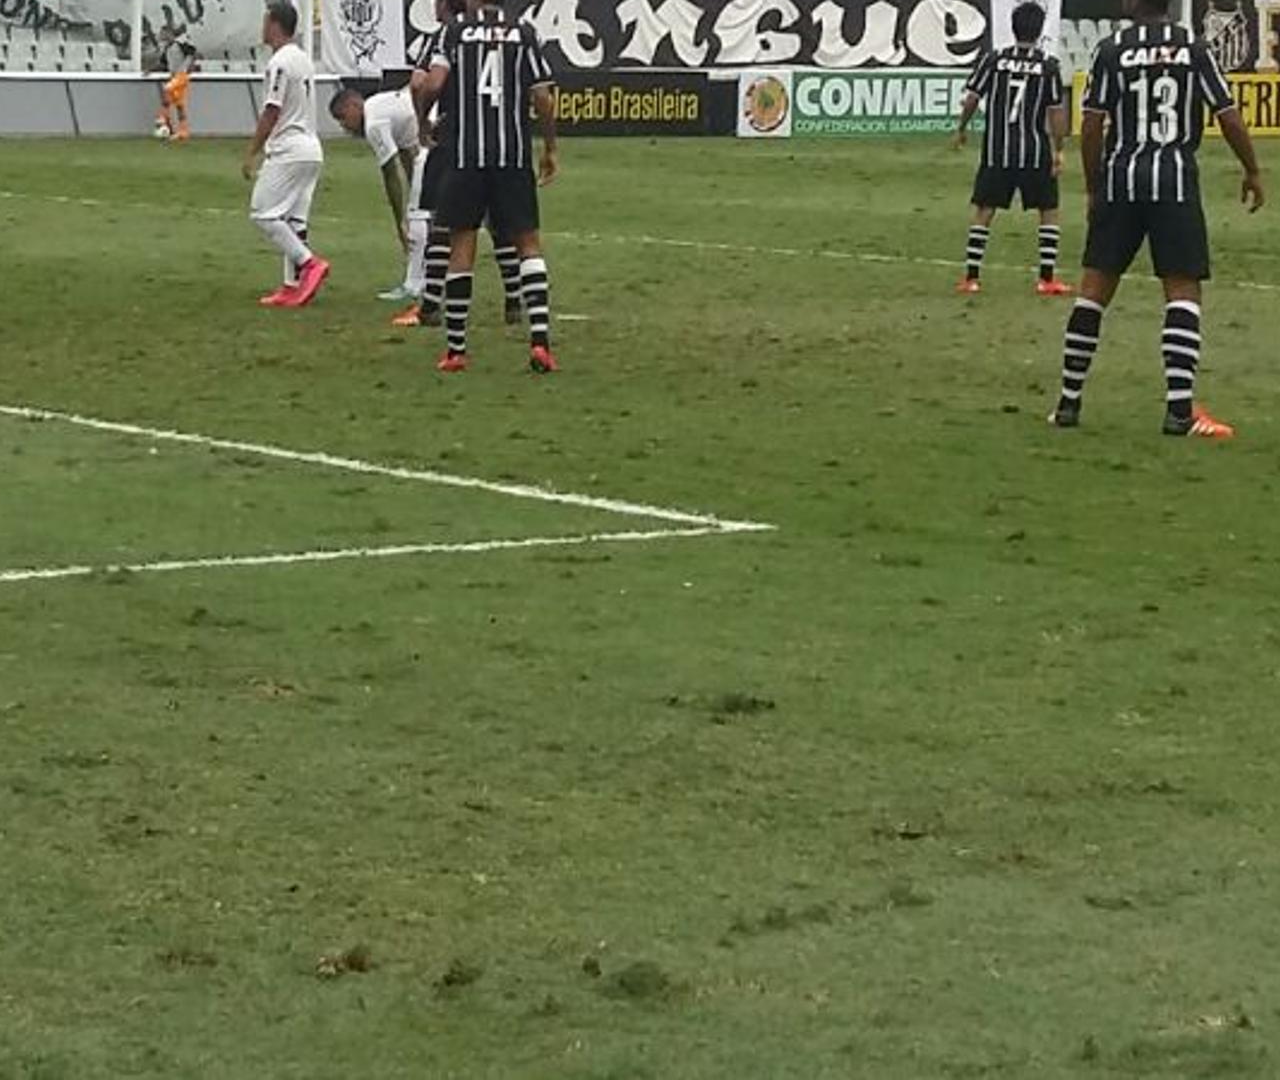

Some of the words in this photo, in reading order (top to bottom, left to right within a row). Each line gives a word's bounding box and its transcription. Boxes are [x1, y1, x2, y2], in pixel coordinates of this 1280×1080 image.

[461, 25, 521, 43] CAIXA
[996, 58, 1043, 75] CAIXA
[1119, 46, 1192, 67] CAIXA
[477, 49, 502, 108] 4
[609, 85, 699, 120] Brasileira
[1008, 78, 1027, 123] 7
[1128, 77, 1179, 144] 13
